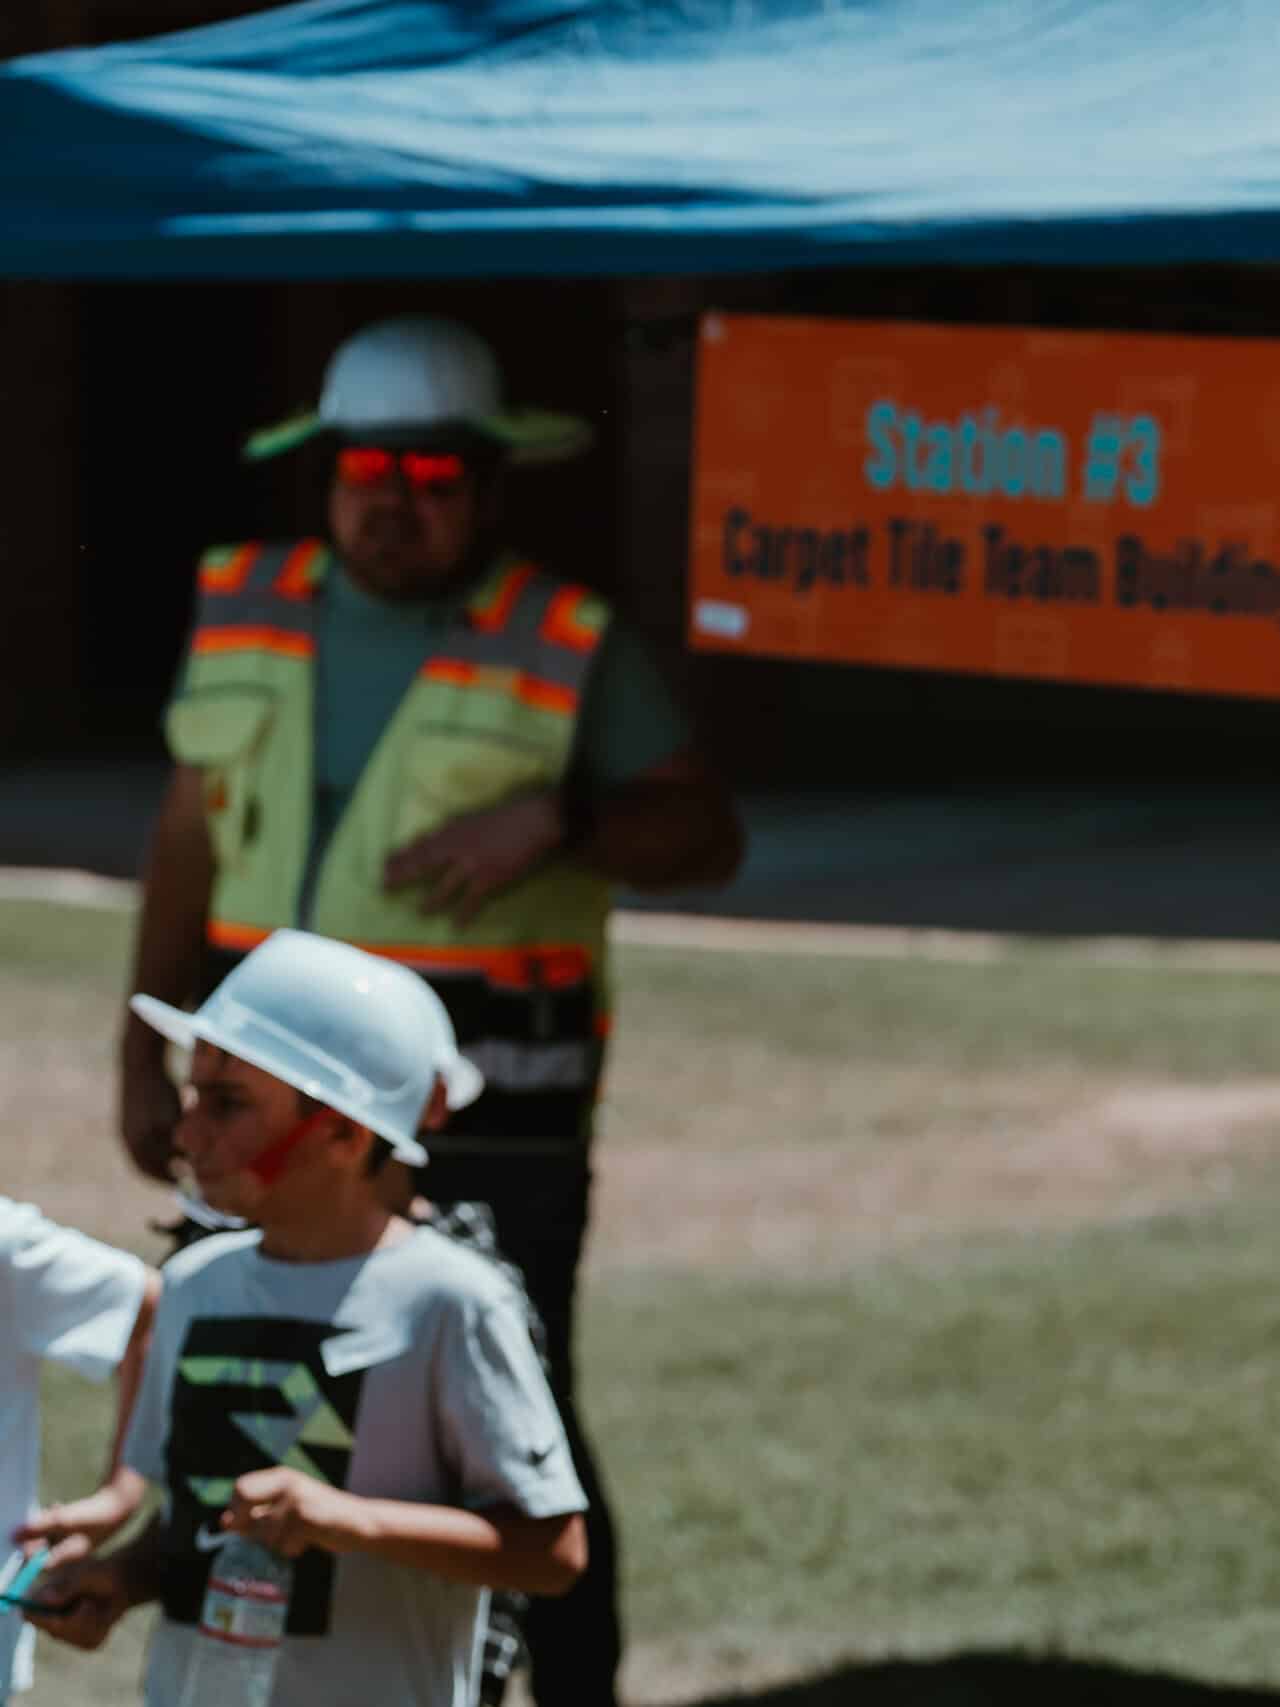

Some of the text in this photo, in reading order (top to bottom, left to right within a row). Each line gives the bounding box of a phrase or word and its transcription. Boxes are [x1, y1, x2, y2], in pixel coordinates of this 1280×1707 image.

[865, 400, 1160, 506] Station #3
[722, 507, 871, 591] Carpet
[886, 516, 964, 594] Tile
[983, 523, 1099, 602] Team
